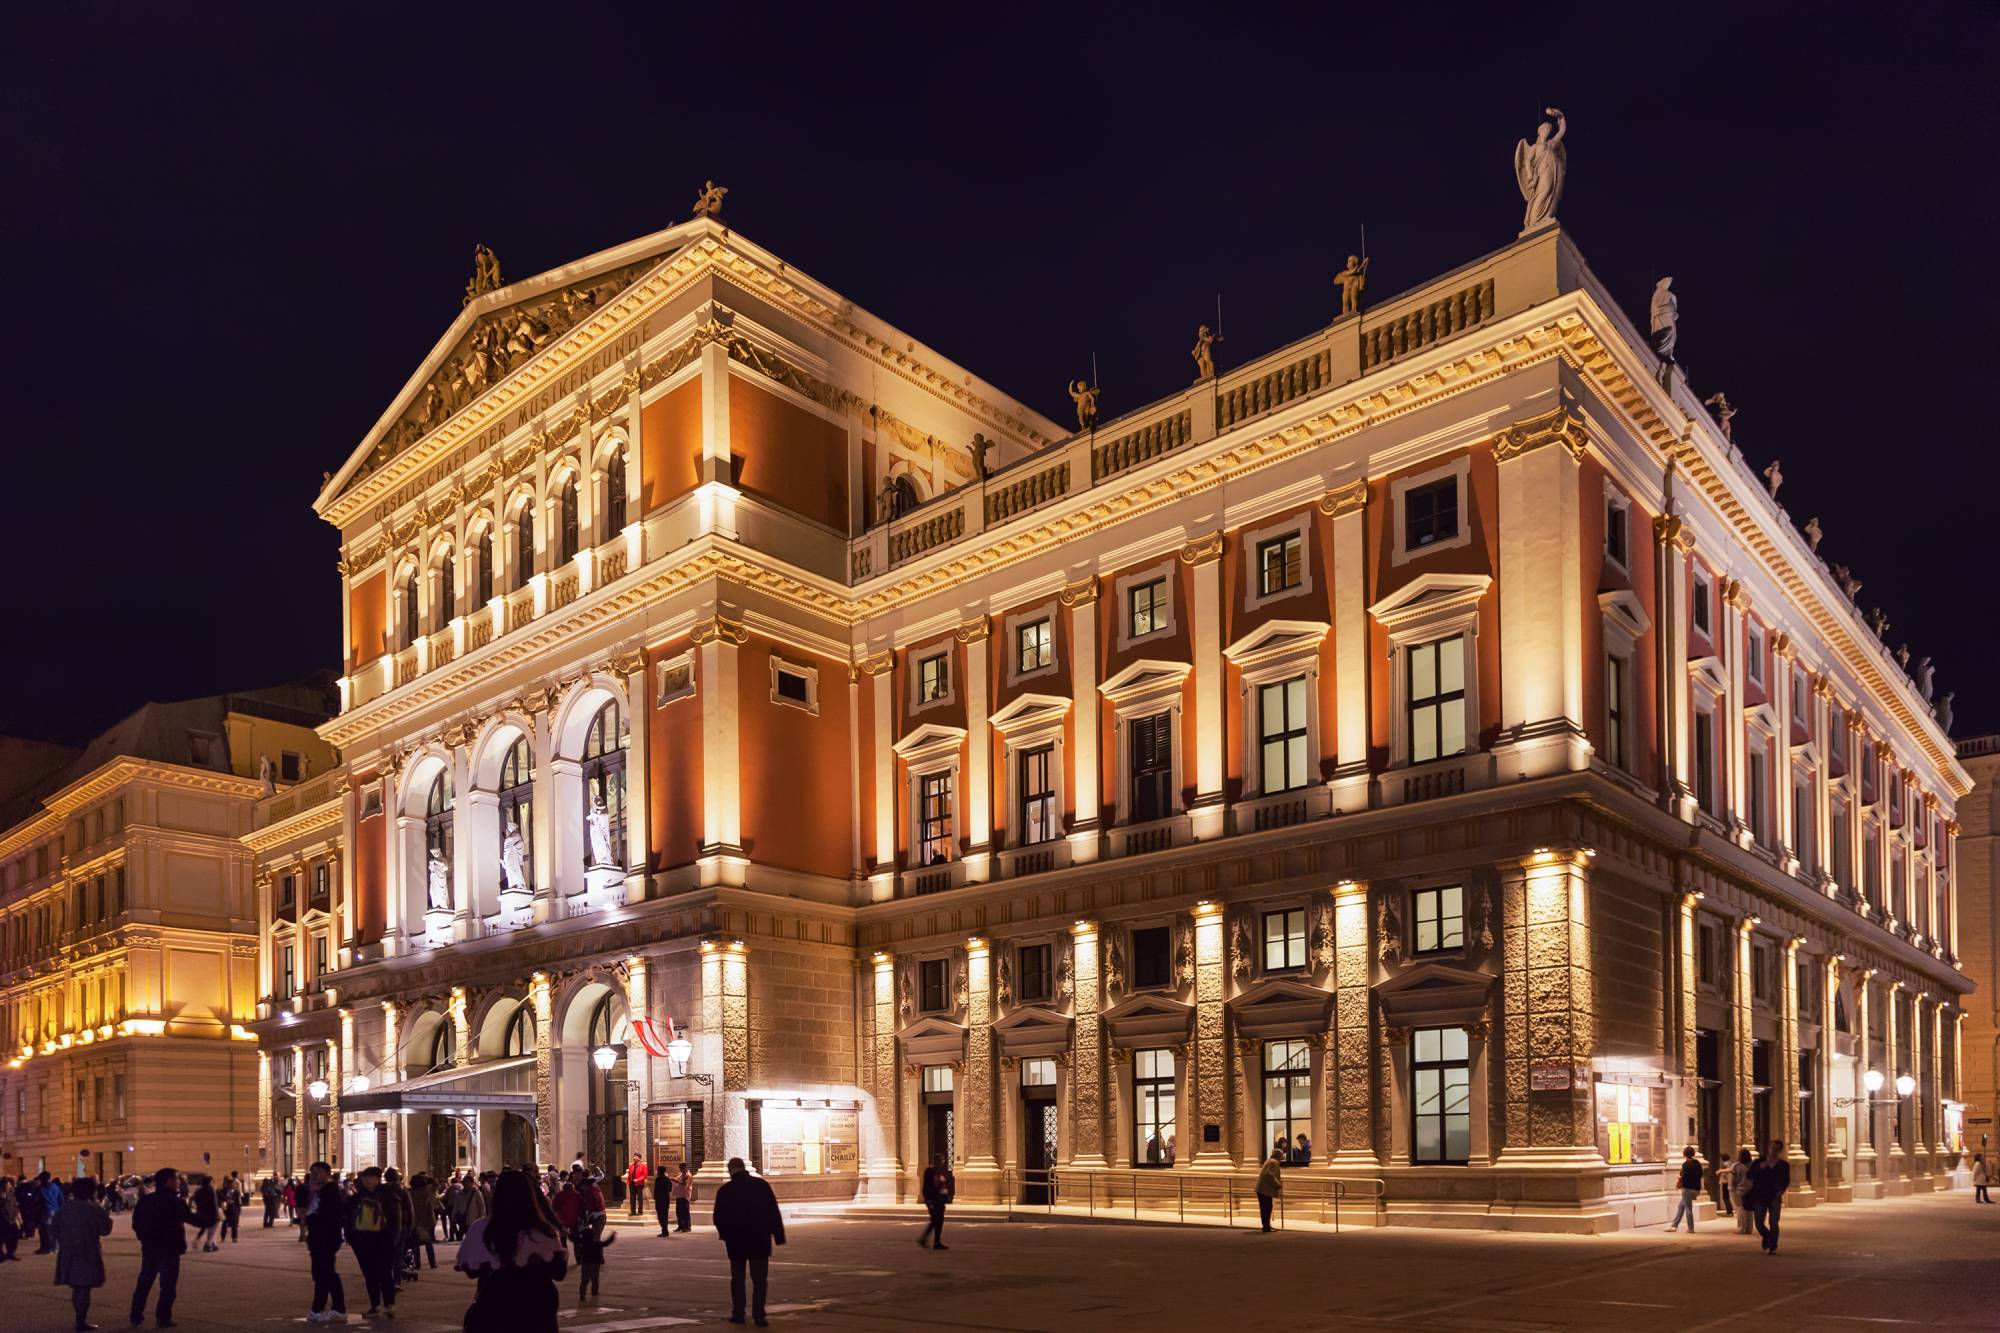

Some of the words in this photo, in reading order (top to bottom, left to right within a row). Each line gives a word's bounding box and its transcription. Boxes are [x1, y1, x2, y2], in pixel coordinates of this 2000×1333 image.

[374, 446, 469, 521] GESELLSCHAFT
[479, 422, 506, 453] DER
[518, 322, 651, 427] MUSIKFREUNDE
[831, 1153, 857, 1162] CHAILLY
